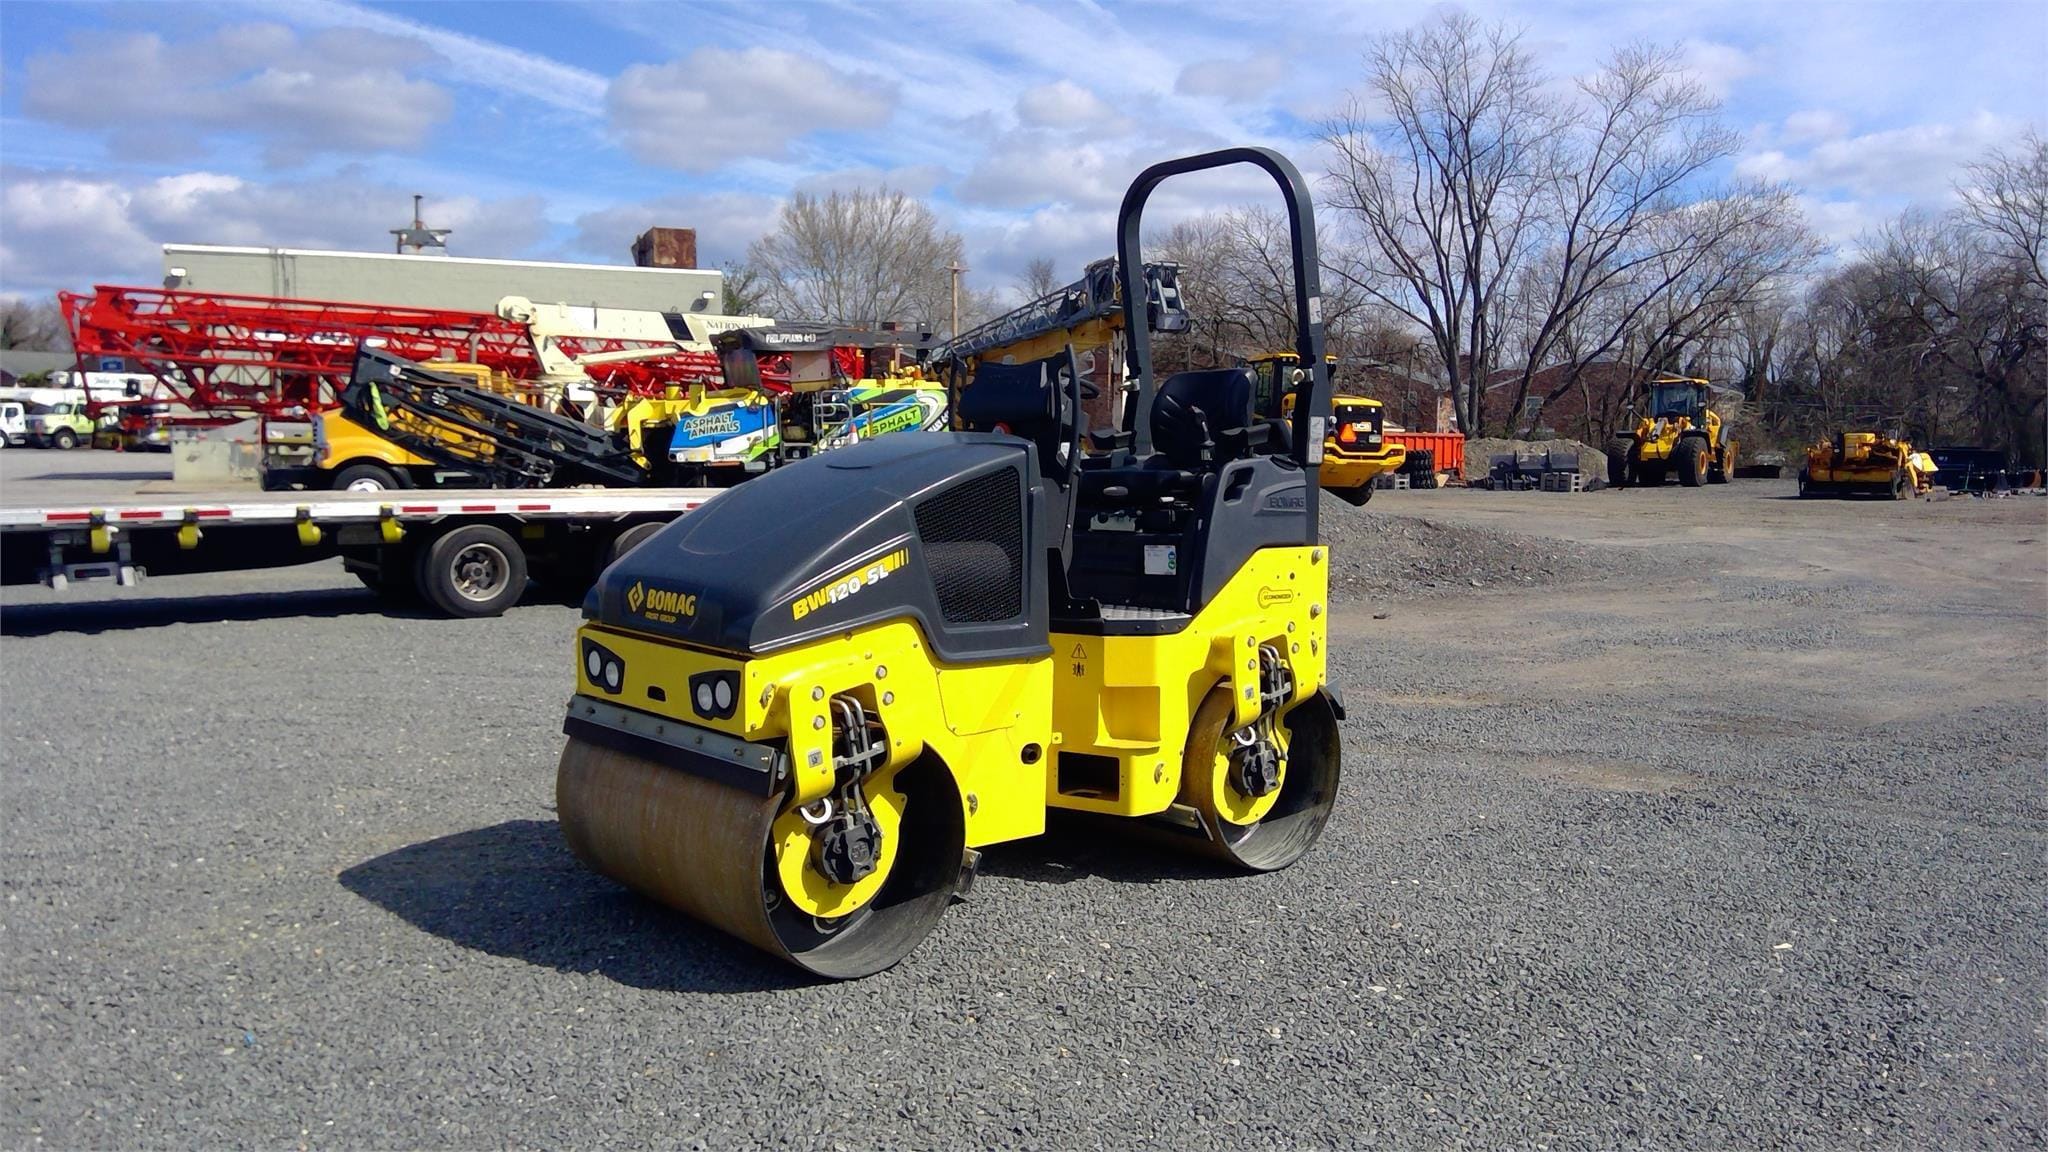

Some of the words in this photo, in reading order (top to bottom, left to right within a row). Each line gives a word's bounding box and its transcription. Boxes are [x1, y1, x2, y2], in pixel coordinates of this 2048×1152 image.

[684, 412, 734, 431] ASPHALT
[690, 422, 740, 439] ANIMALS
[863, 409, 918, 437] ASPHALT
[867, 563, 889, 586] SL
[646, 588, 697, 616] BOMAG
